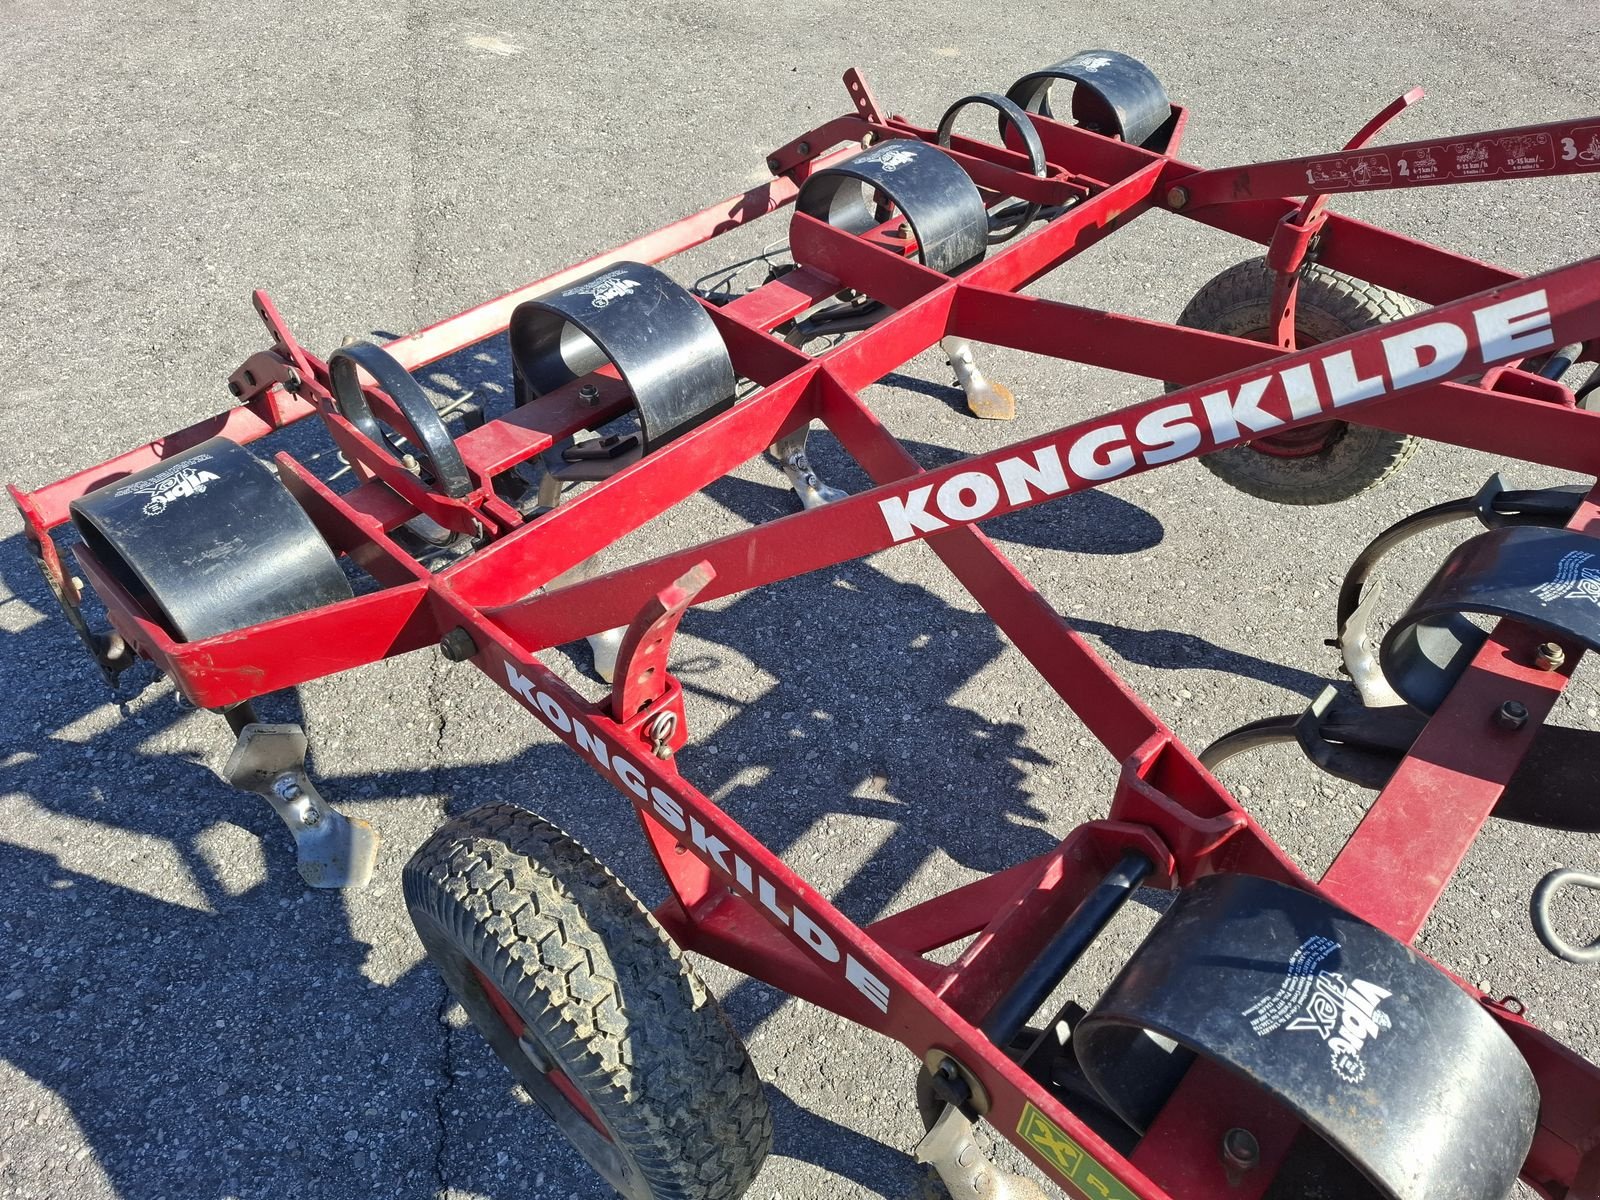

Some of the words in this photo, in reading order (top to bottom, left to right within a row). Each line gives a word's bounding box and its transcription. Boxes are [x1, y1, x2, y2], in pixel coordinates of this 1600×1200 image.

[1397, 159, 1410, 176] 2
[1561, 137, 1578, 160] 3
[1306, 169, 1315, 184] 1
[878, 289, 1556, 543] KONGSKILDE
[503, 659, 891, 1014] KONGSKILDE
[1286, 970, 1348, 1040] flex
